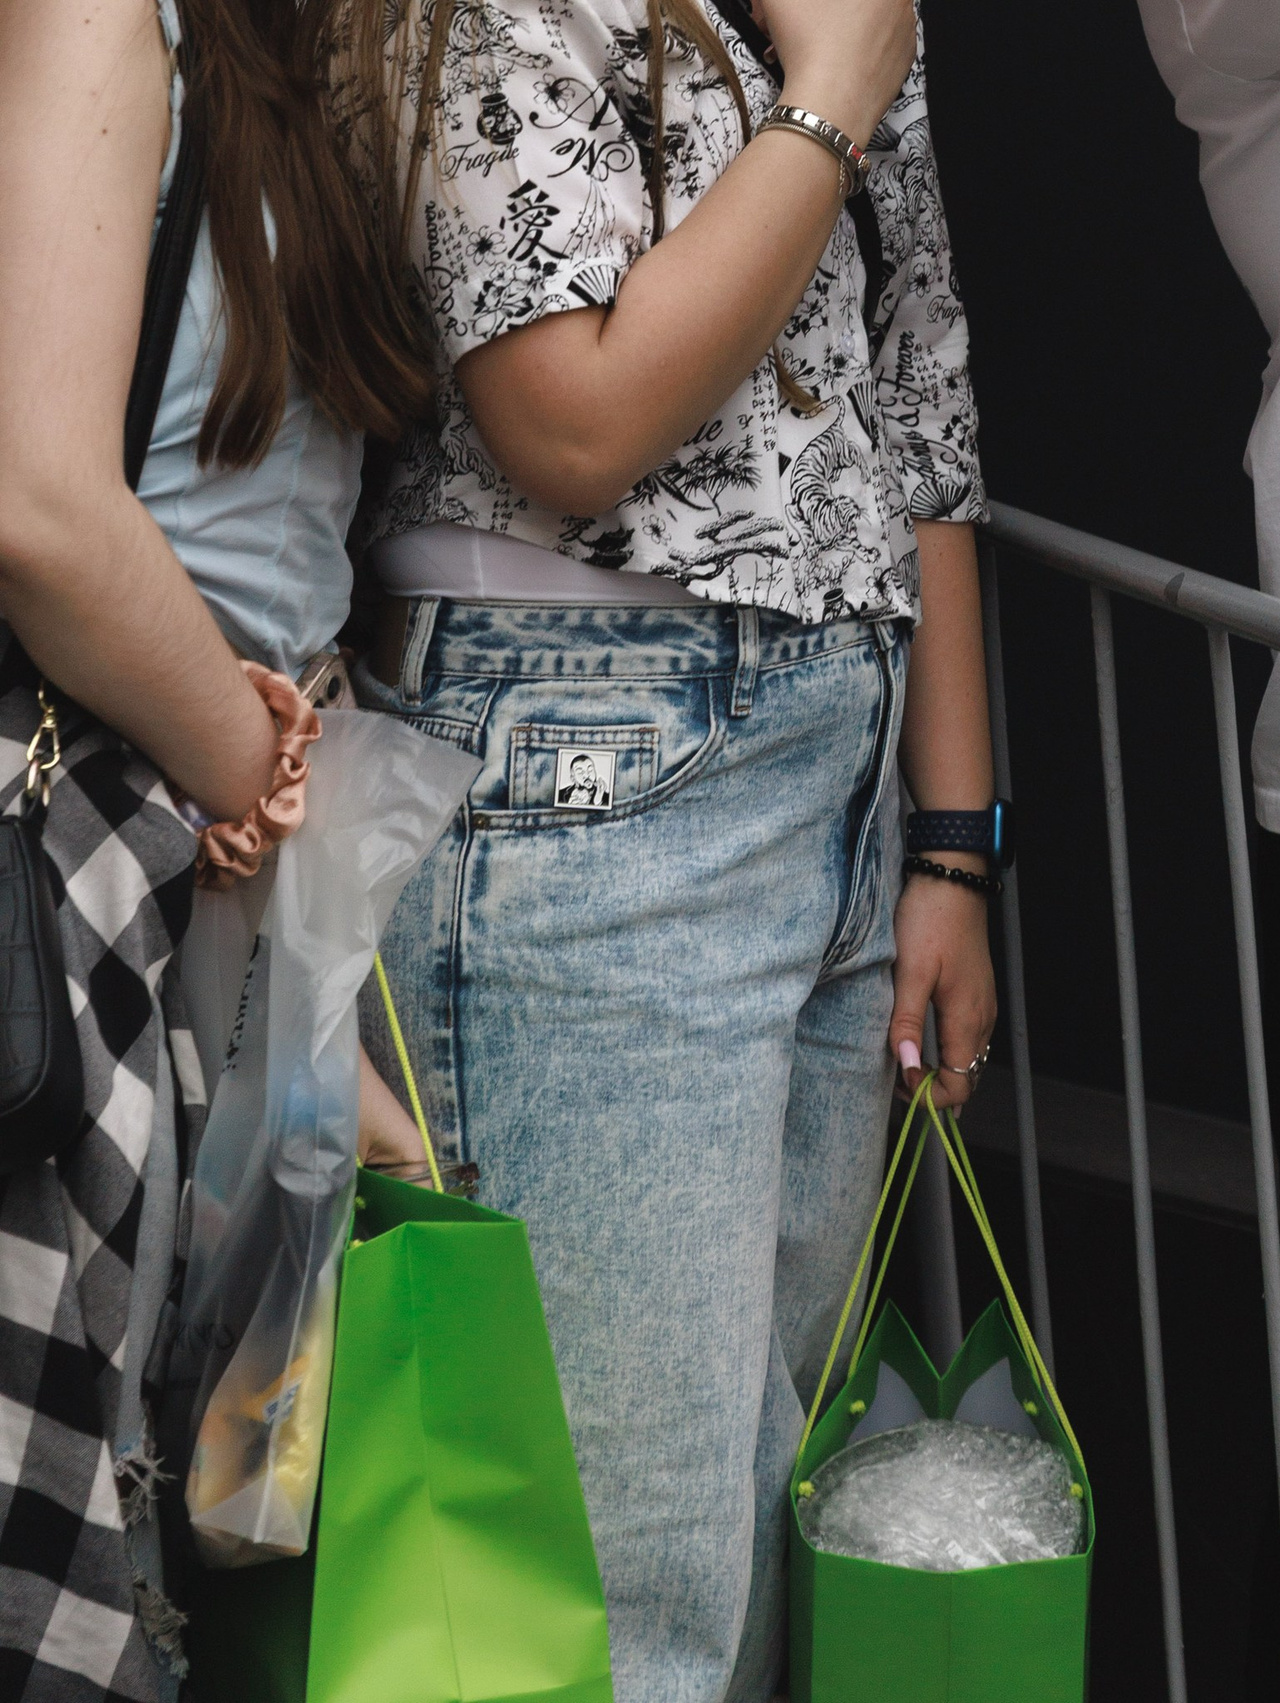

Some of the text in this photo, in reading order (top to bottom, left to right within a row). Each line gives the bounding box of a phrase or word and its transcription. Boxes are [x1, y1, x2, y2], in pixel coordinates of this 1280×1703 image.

[439, 140, 520, 182] Fragile
[547, 137, 635, 182] Me
[499, 179, 571, 262] 愛
[875, 330, 923, 408] Forever
